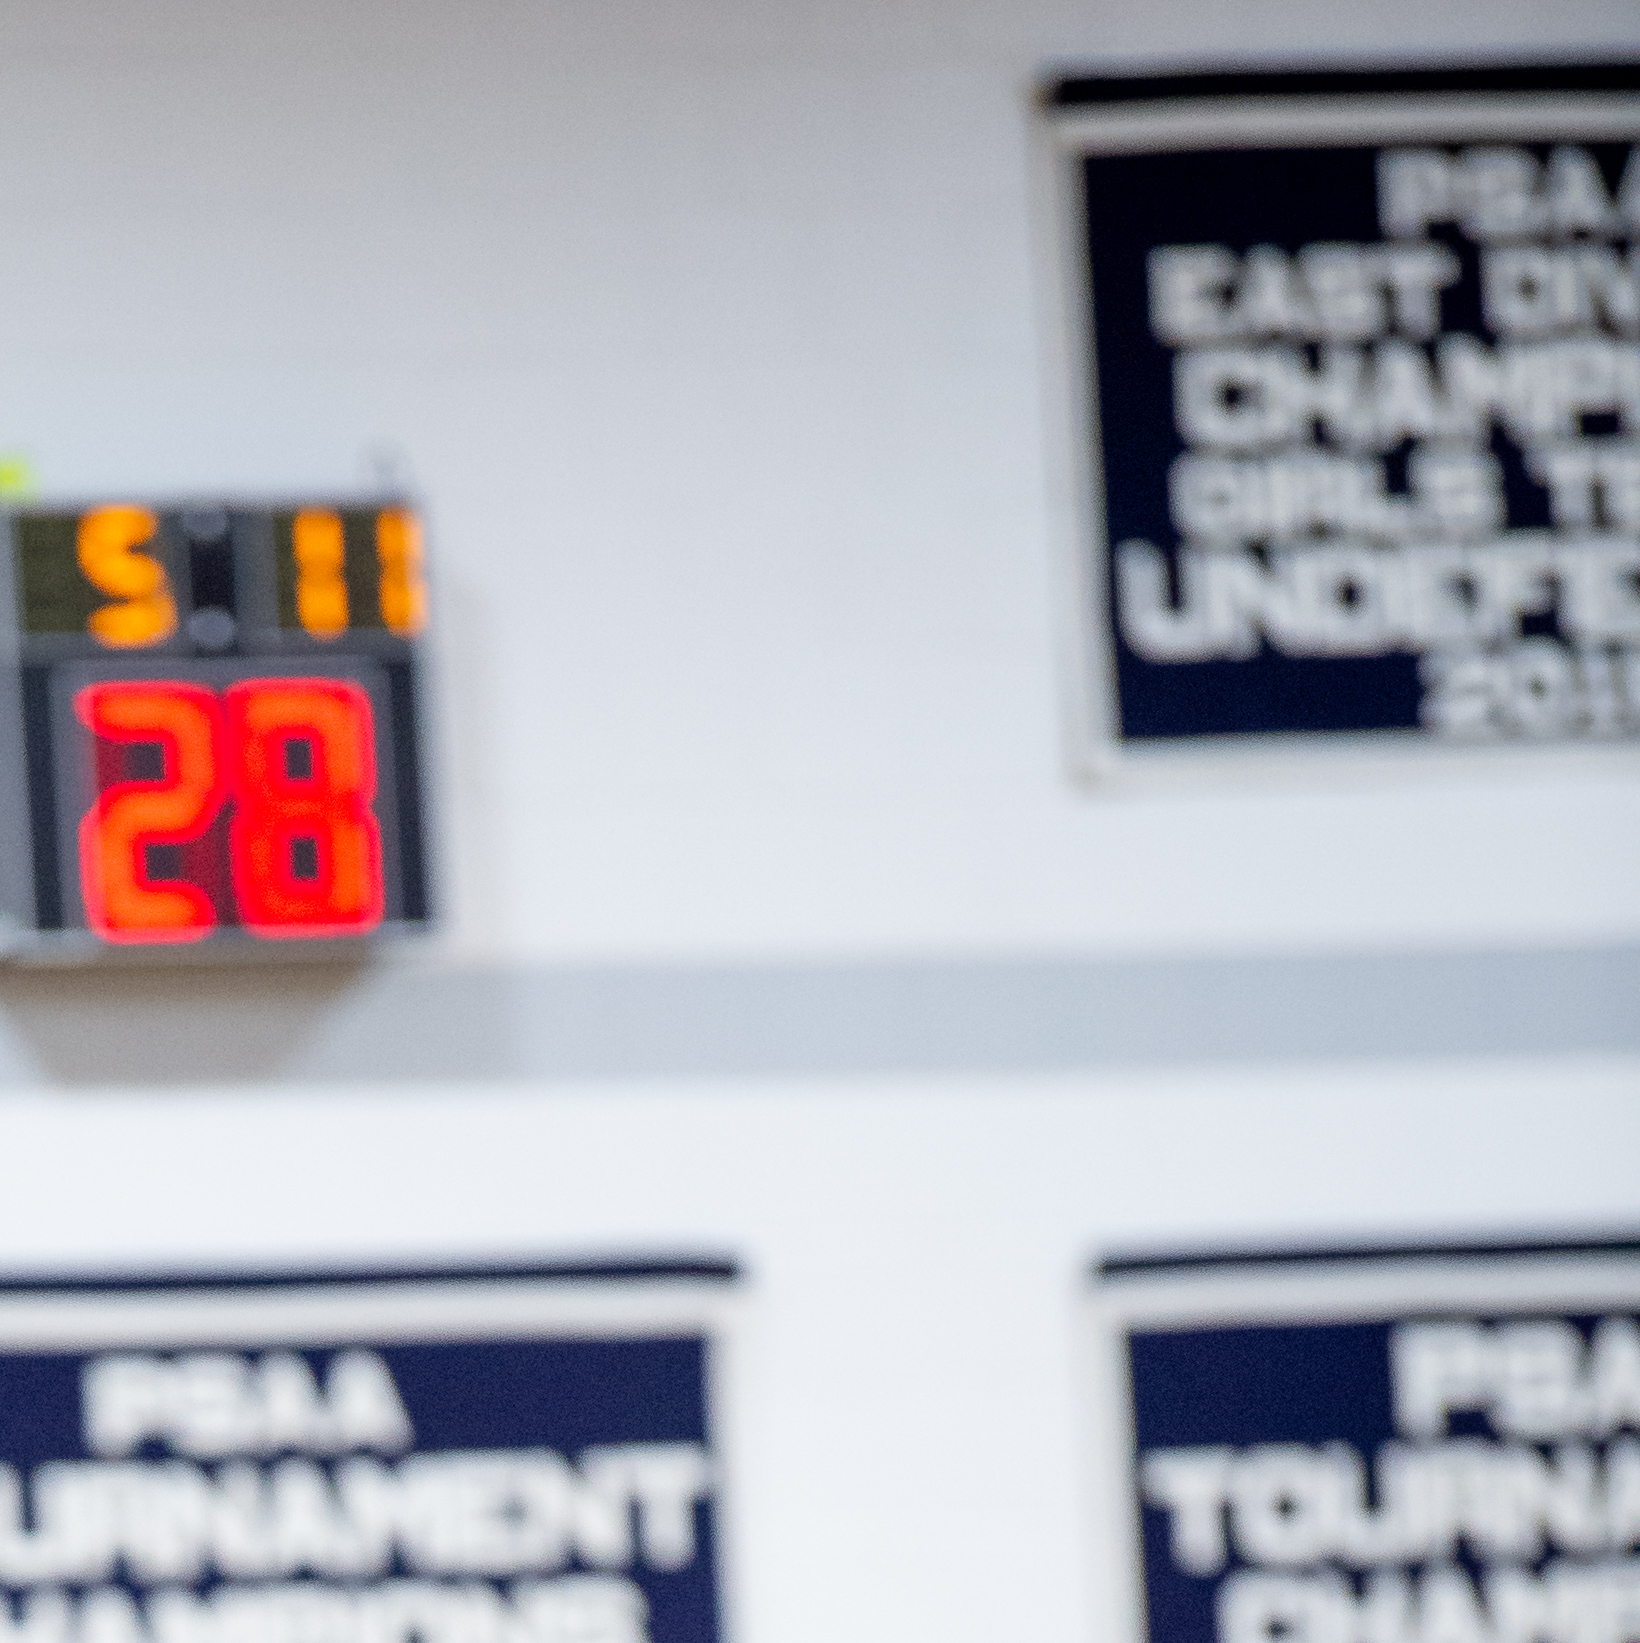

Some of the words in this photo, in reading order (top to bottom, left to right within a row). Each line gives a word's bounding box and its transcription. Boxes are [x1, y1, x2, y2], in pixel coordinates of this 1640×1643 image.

[1377, 147, 1640, 243] PSA
[1147, 243, 1461, 343] EAST
[1169, 451, 1506, 545] GIRLS
[72, 676, 385, 946] 28
[81, 1350, 415, 1459] PSAA
